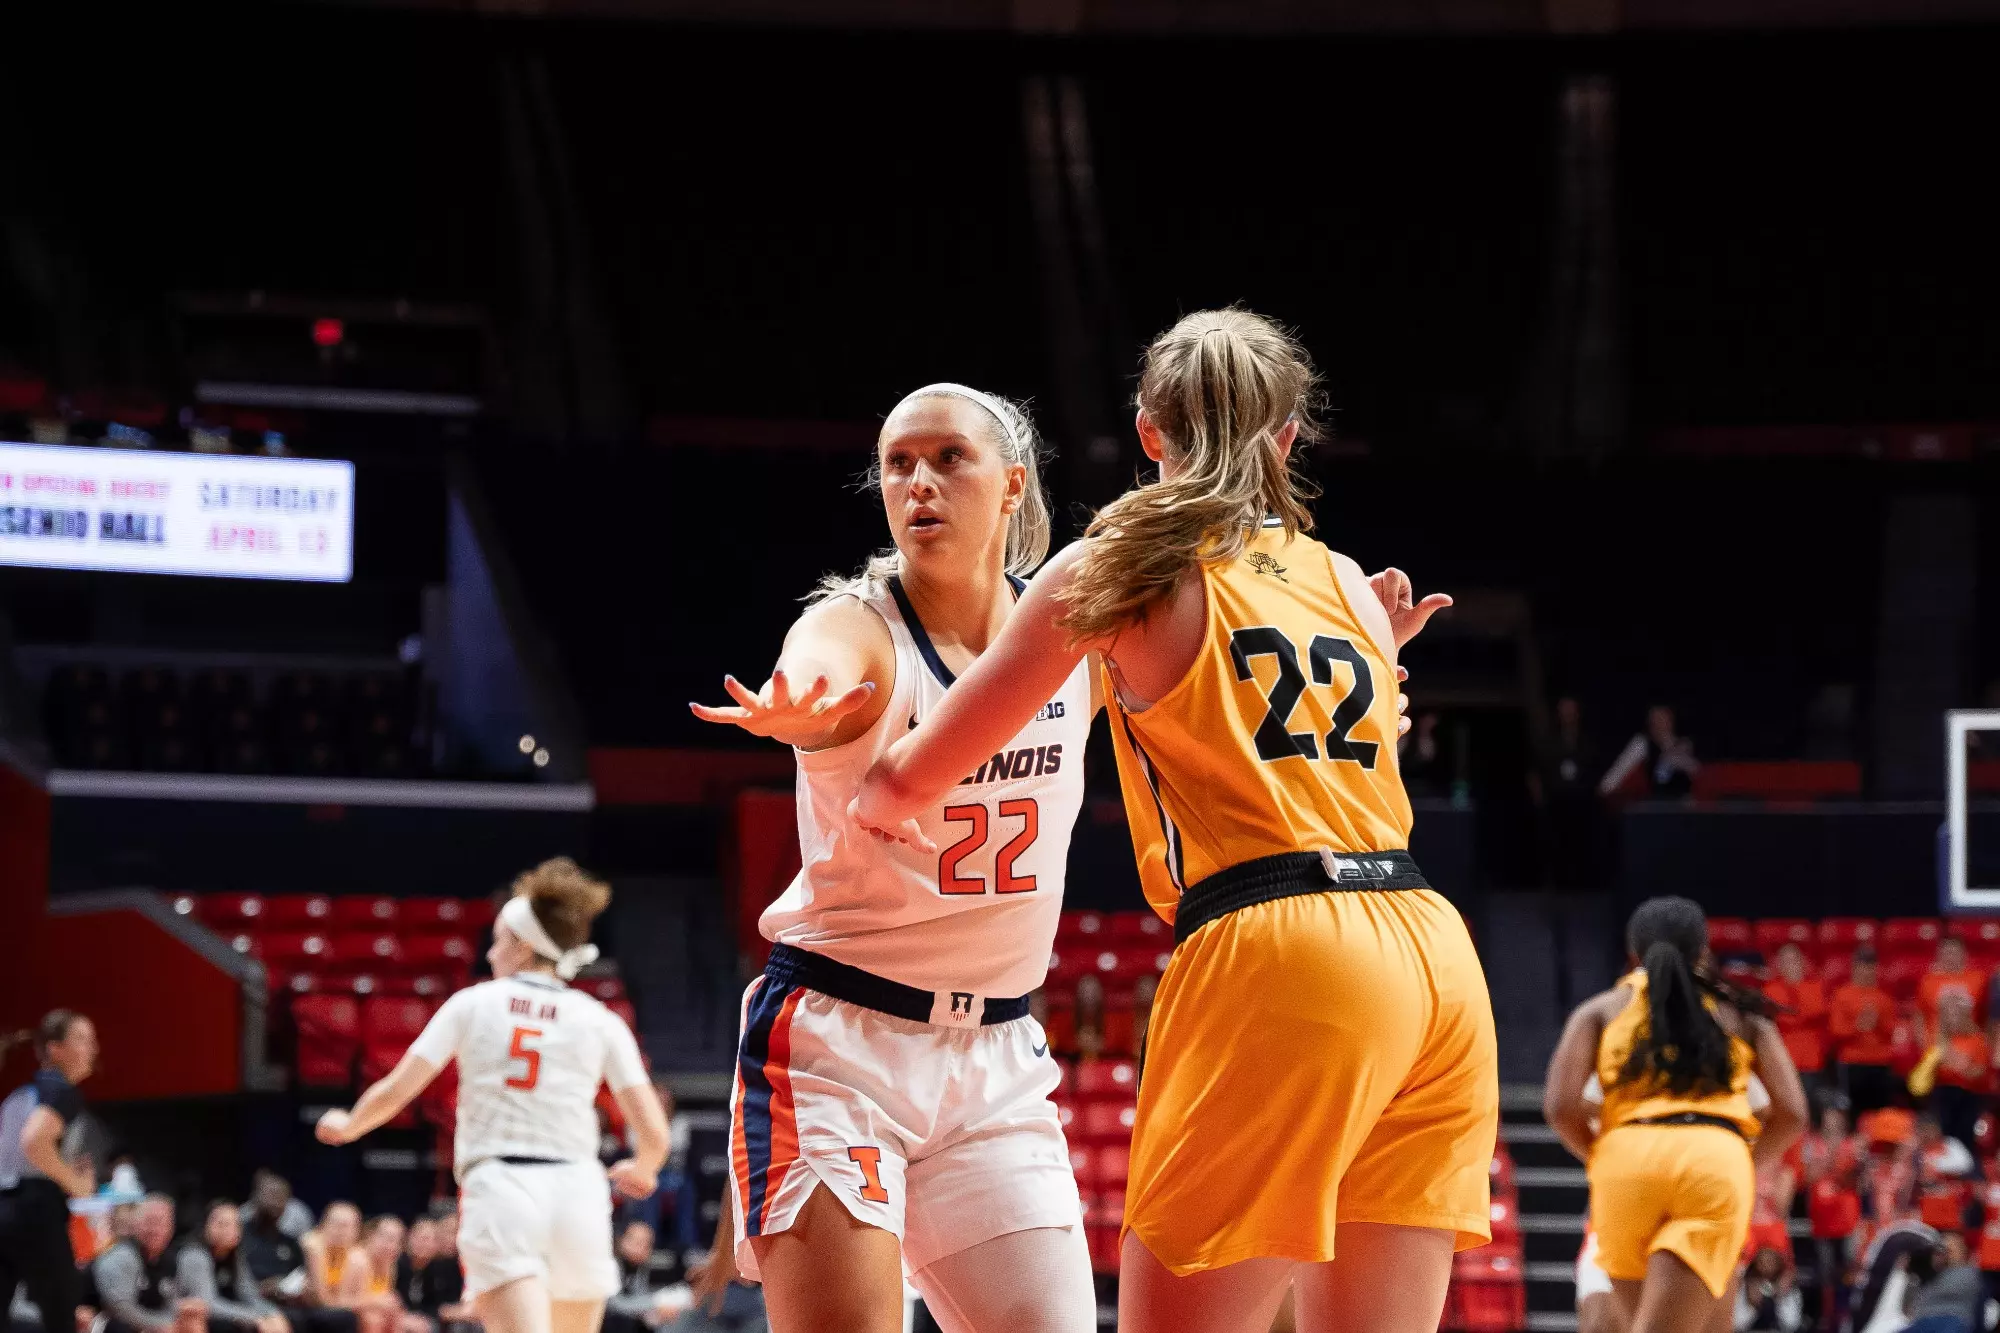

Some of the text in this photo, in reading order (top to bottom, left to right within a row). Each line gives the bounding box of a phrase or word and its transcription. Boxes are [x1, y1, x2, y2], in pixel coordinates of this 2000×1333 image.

[201, 481, 336, 511] SATURDAY
[100, 512, 164, 543] HALL
[206, 525, 281, 552] APRIL
[1231, 627, 1379, 771] 22
[939, 798, 1038, 895] 22
[505, 1025, 543, 1091] 5
[848, 1146, 889, 1204] I
